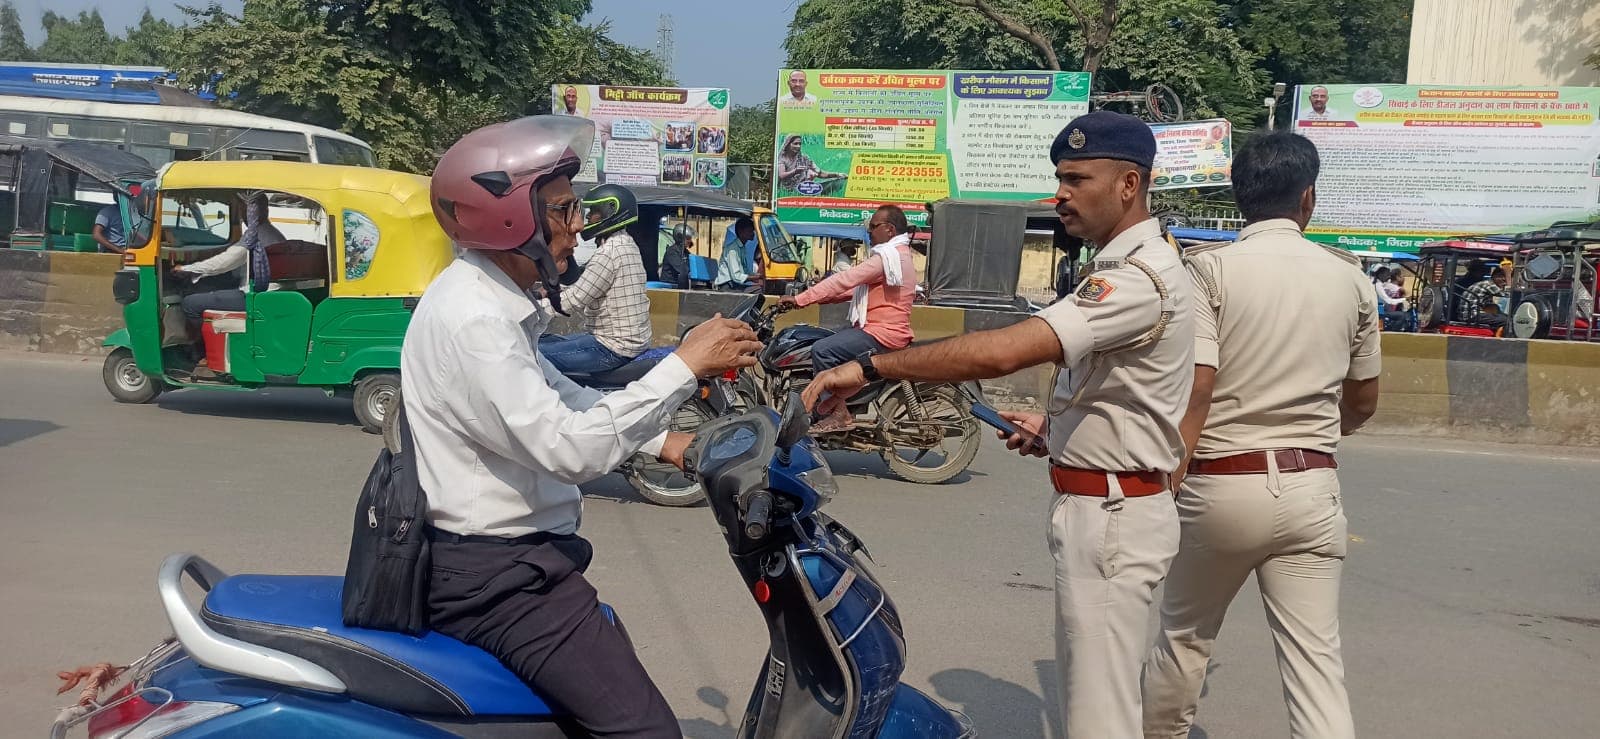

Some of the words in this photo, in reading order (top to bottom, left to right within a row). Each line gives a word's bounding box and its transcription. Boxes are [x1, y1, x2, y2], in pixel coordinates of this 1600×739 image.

[822, 75, 846, 85] उर्वरक
[867, 75, 881, 85] करें
[882, 75, 904, 85] उचित
[907, 76, 926, 88] मूल्य
[928, 77, 941, 85] पर
[1420, 100, 1434, 109] लिए
[1436, 101, 1456, 109] डीजल
[1458, 101, 1482, 111] अनुदान
[1484, 101, 1494, 109] का
[856, 166, 943, 177] 0612-2233555
